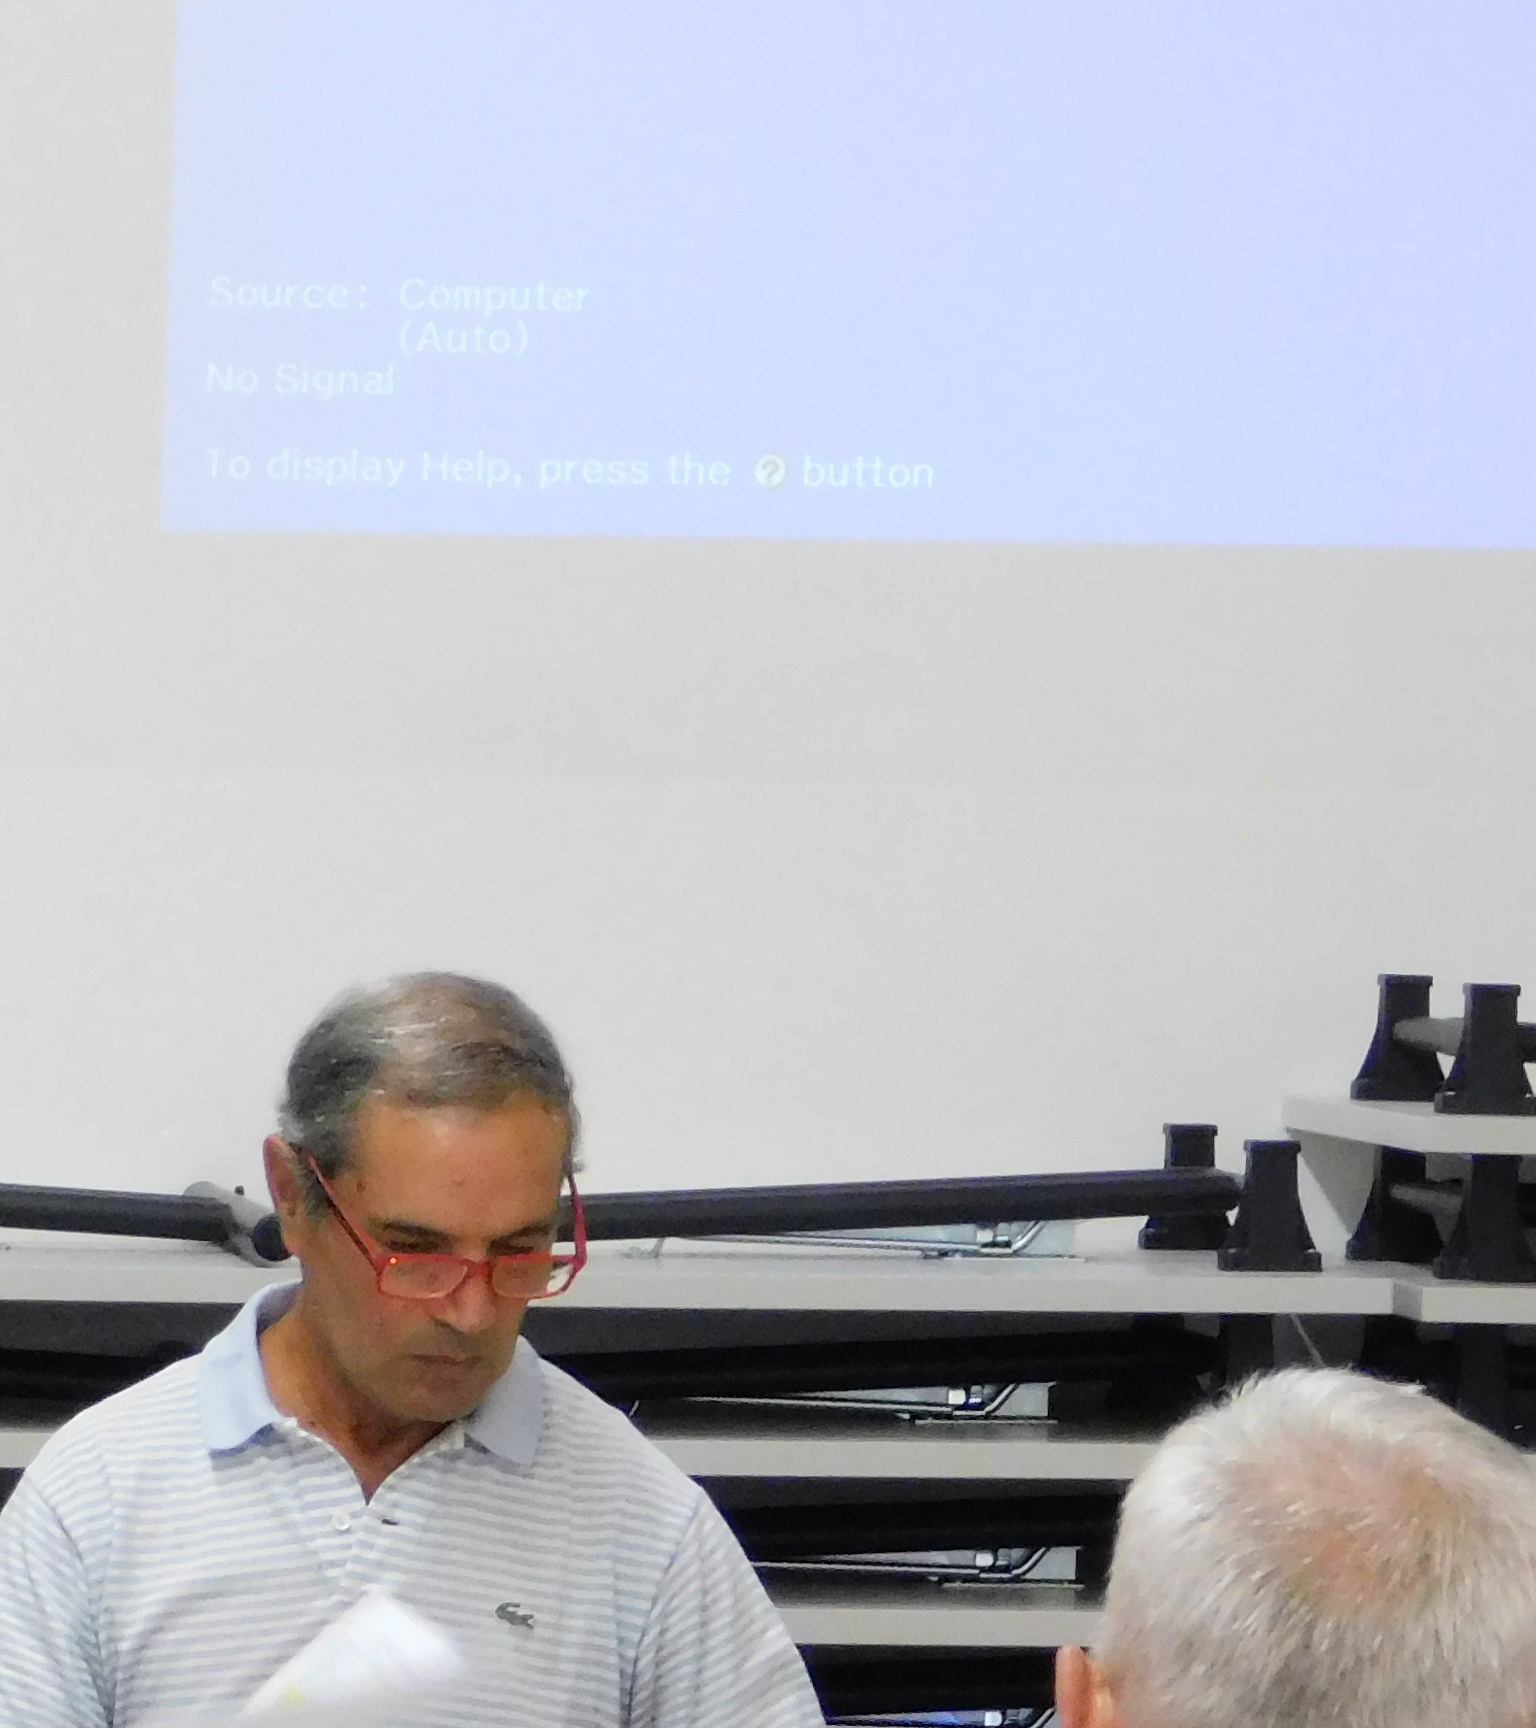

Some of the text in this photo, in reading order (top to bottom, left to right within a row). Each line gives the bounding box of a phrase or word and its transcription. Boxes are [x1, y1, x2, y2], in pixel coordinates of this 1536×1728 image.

[210, 277, 590, 315] Source: Computer
[398, 320, 530, 355] (Auto)
[206, 363, 396, 400] No Signal
[205, 450, 252, 482] To
[266, 450, 406, 487] display
[422, 450, 524, 490] Help,
[539, 461, 650, 489] press
[668, 453, 732, 487] the
[802, 454, 936, 490] button
